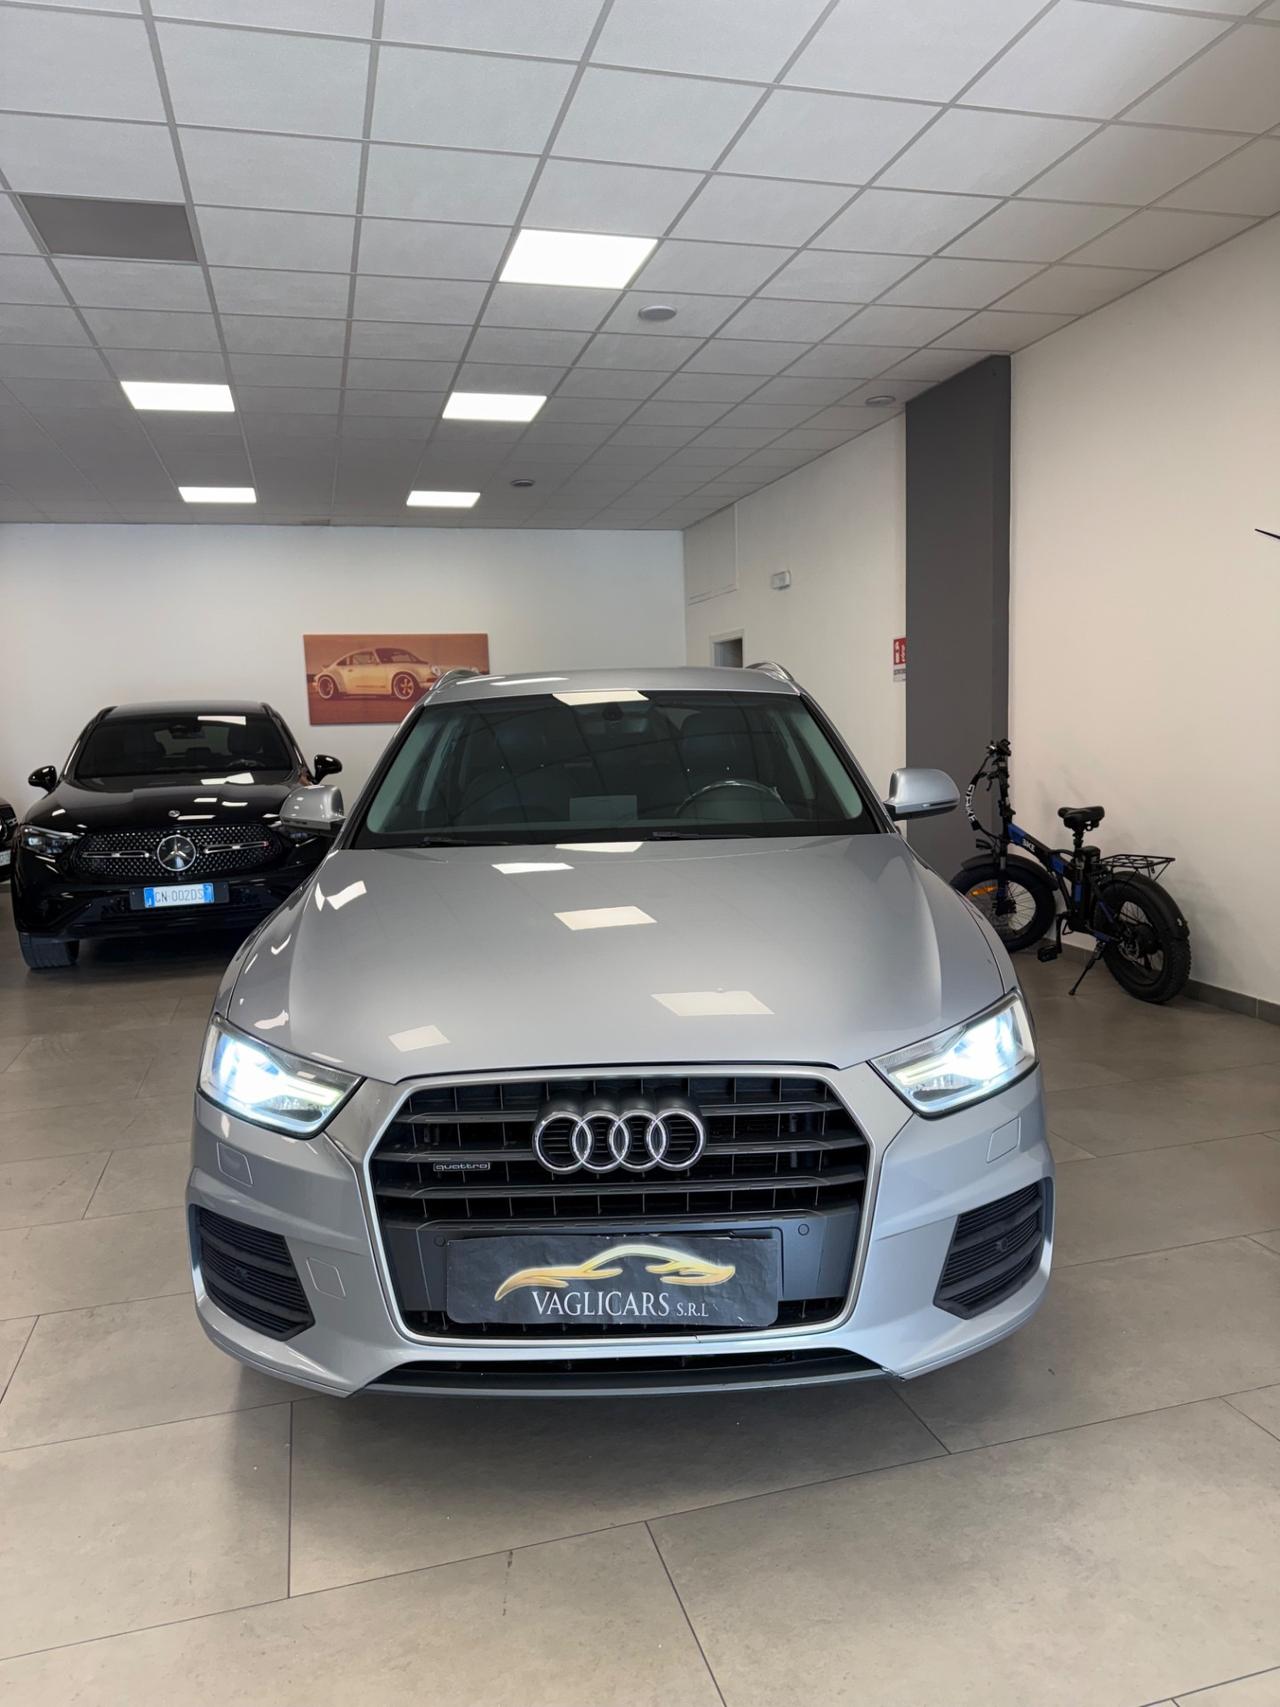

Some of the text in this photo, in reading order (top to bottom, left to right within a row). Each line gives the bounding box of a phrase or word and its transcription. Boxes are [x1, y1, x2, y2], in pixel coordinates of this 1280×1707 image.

[434, 1162, 489, 1171] quattro
[531, 1290, 709, 1317] VAGLICARS S.R.L
